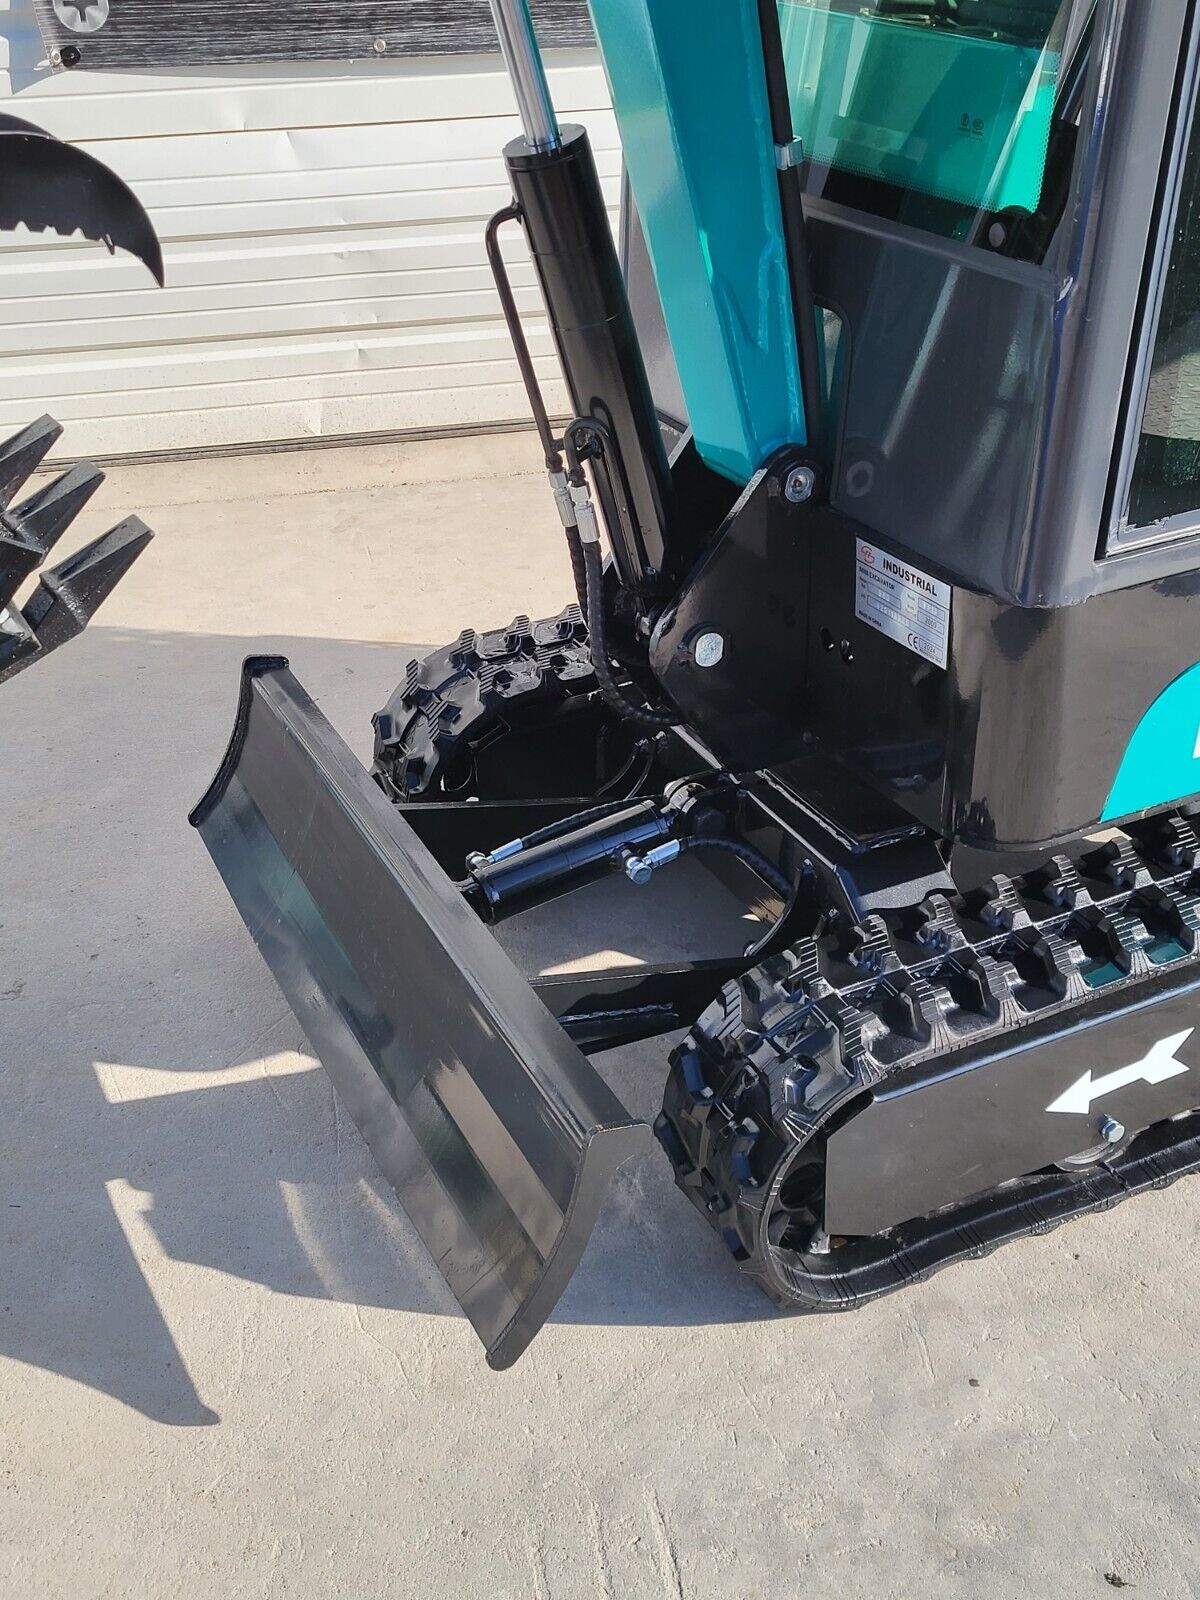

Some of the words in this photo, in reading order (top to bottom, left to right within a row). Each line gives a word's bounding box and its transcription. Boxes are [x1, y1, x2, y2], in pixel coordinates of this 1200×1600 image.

[869, 571, 896, 590] EXCAVATOR
[883, 558, 938, 597] INDUSTRIAL
[907, 633, 919, 651] CE
[924, 643, 936, 655] 2024
